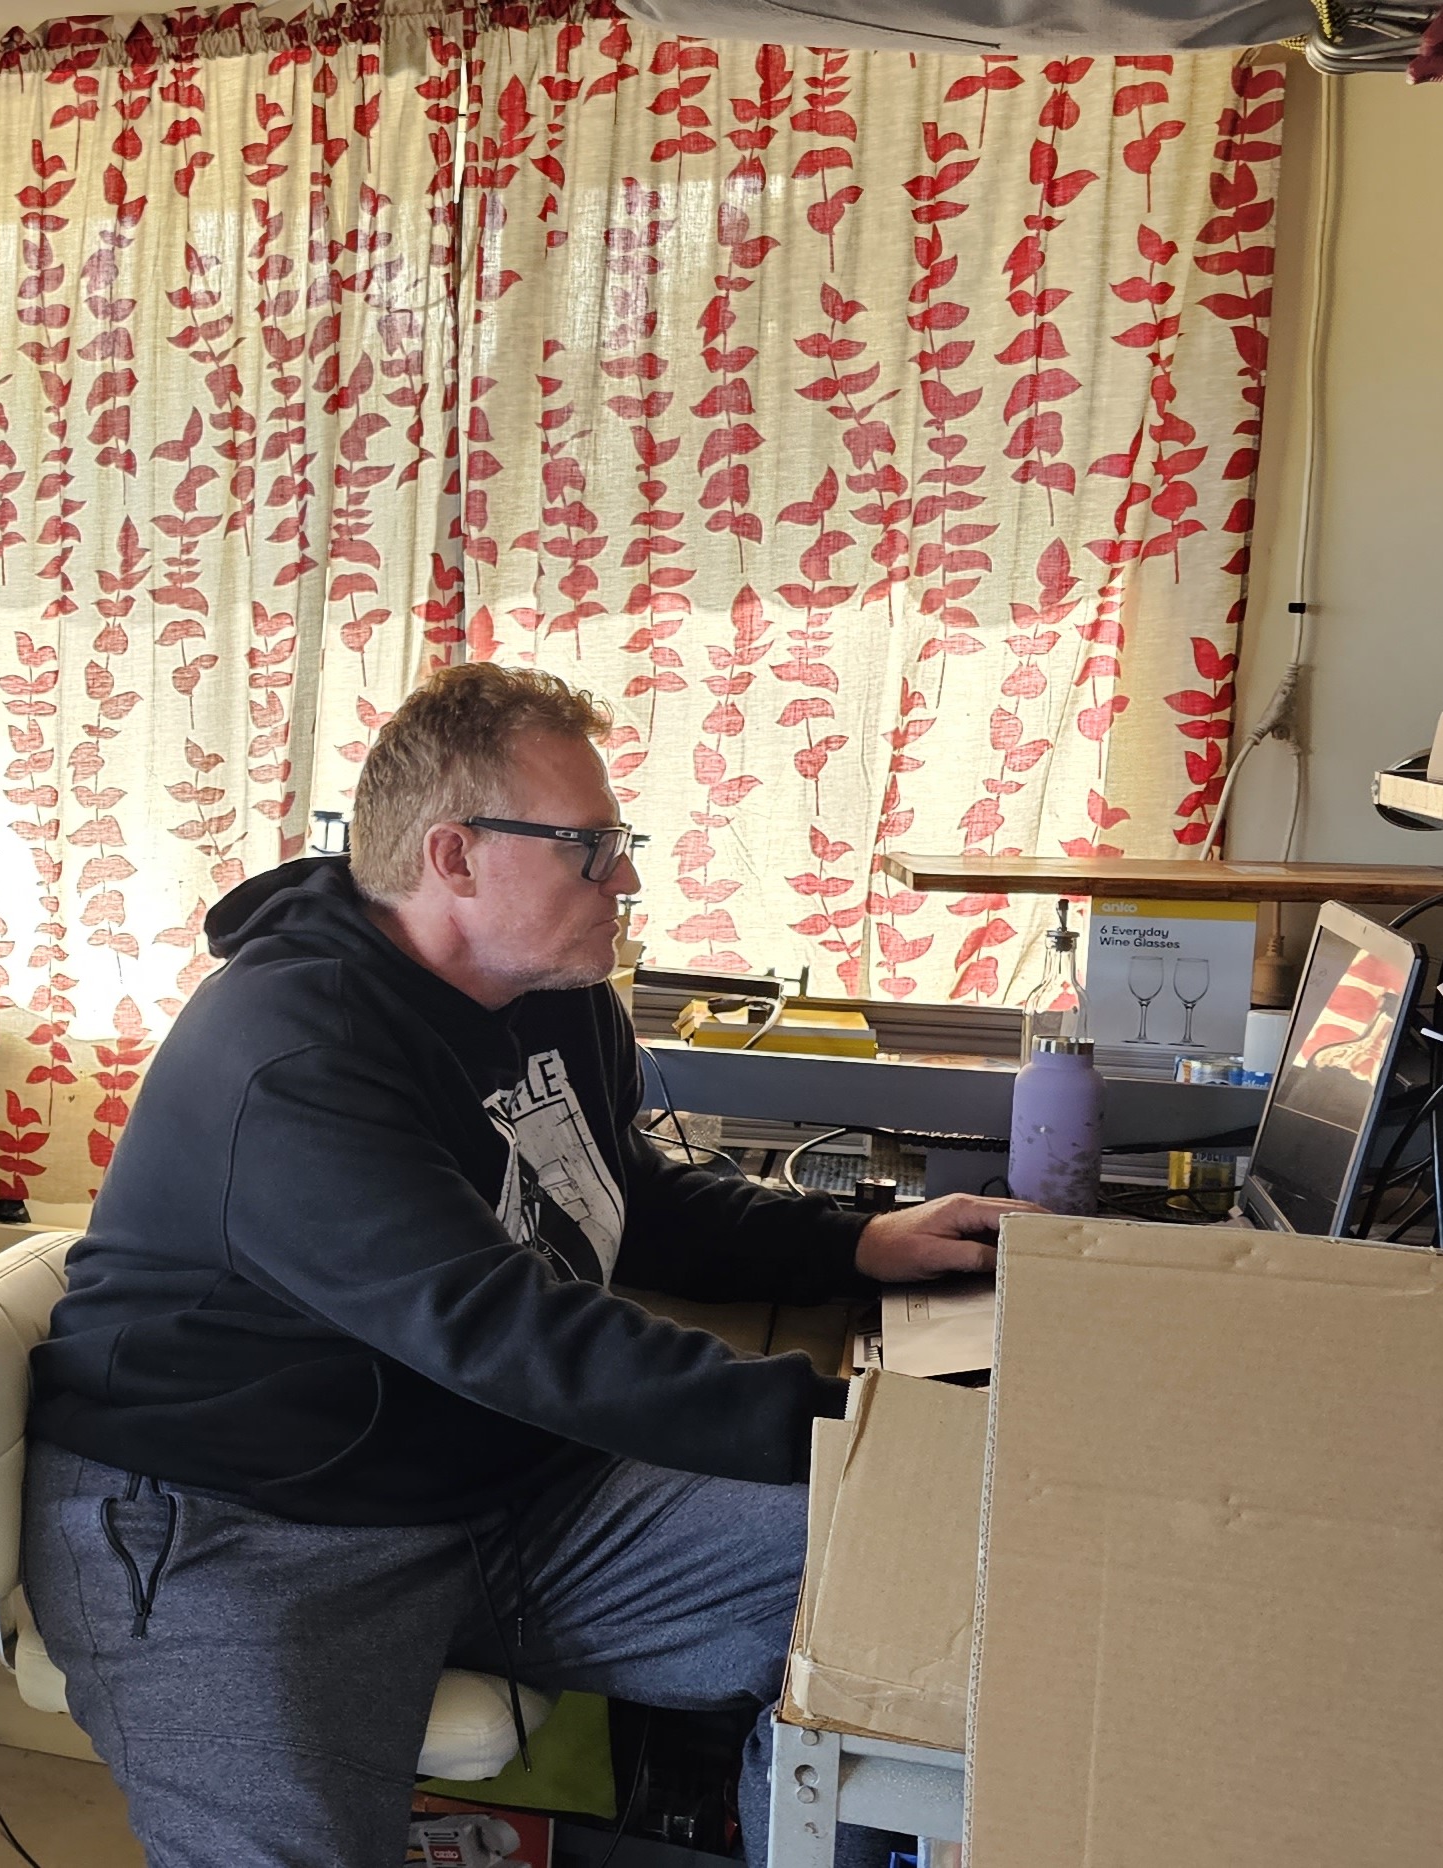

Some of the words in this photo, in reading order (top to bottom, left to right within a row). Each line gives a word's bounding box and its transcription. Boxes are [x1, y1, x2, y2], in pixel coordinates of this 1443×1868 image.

[1101, 902, 1138, 913] anko
[1100, 925, 1108, 935] 6
[1112, 926, 1170, 939] Everyday
[1099, 936, 1130, 947] Wine
[1133, 937, 1181, 949] Glasses
